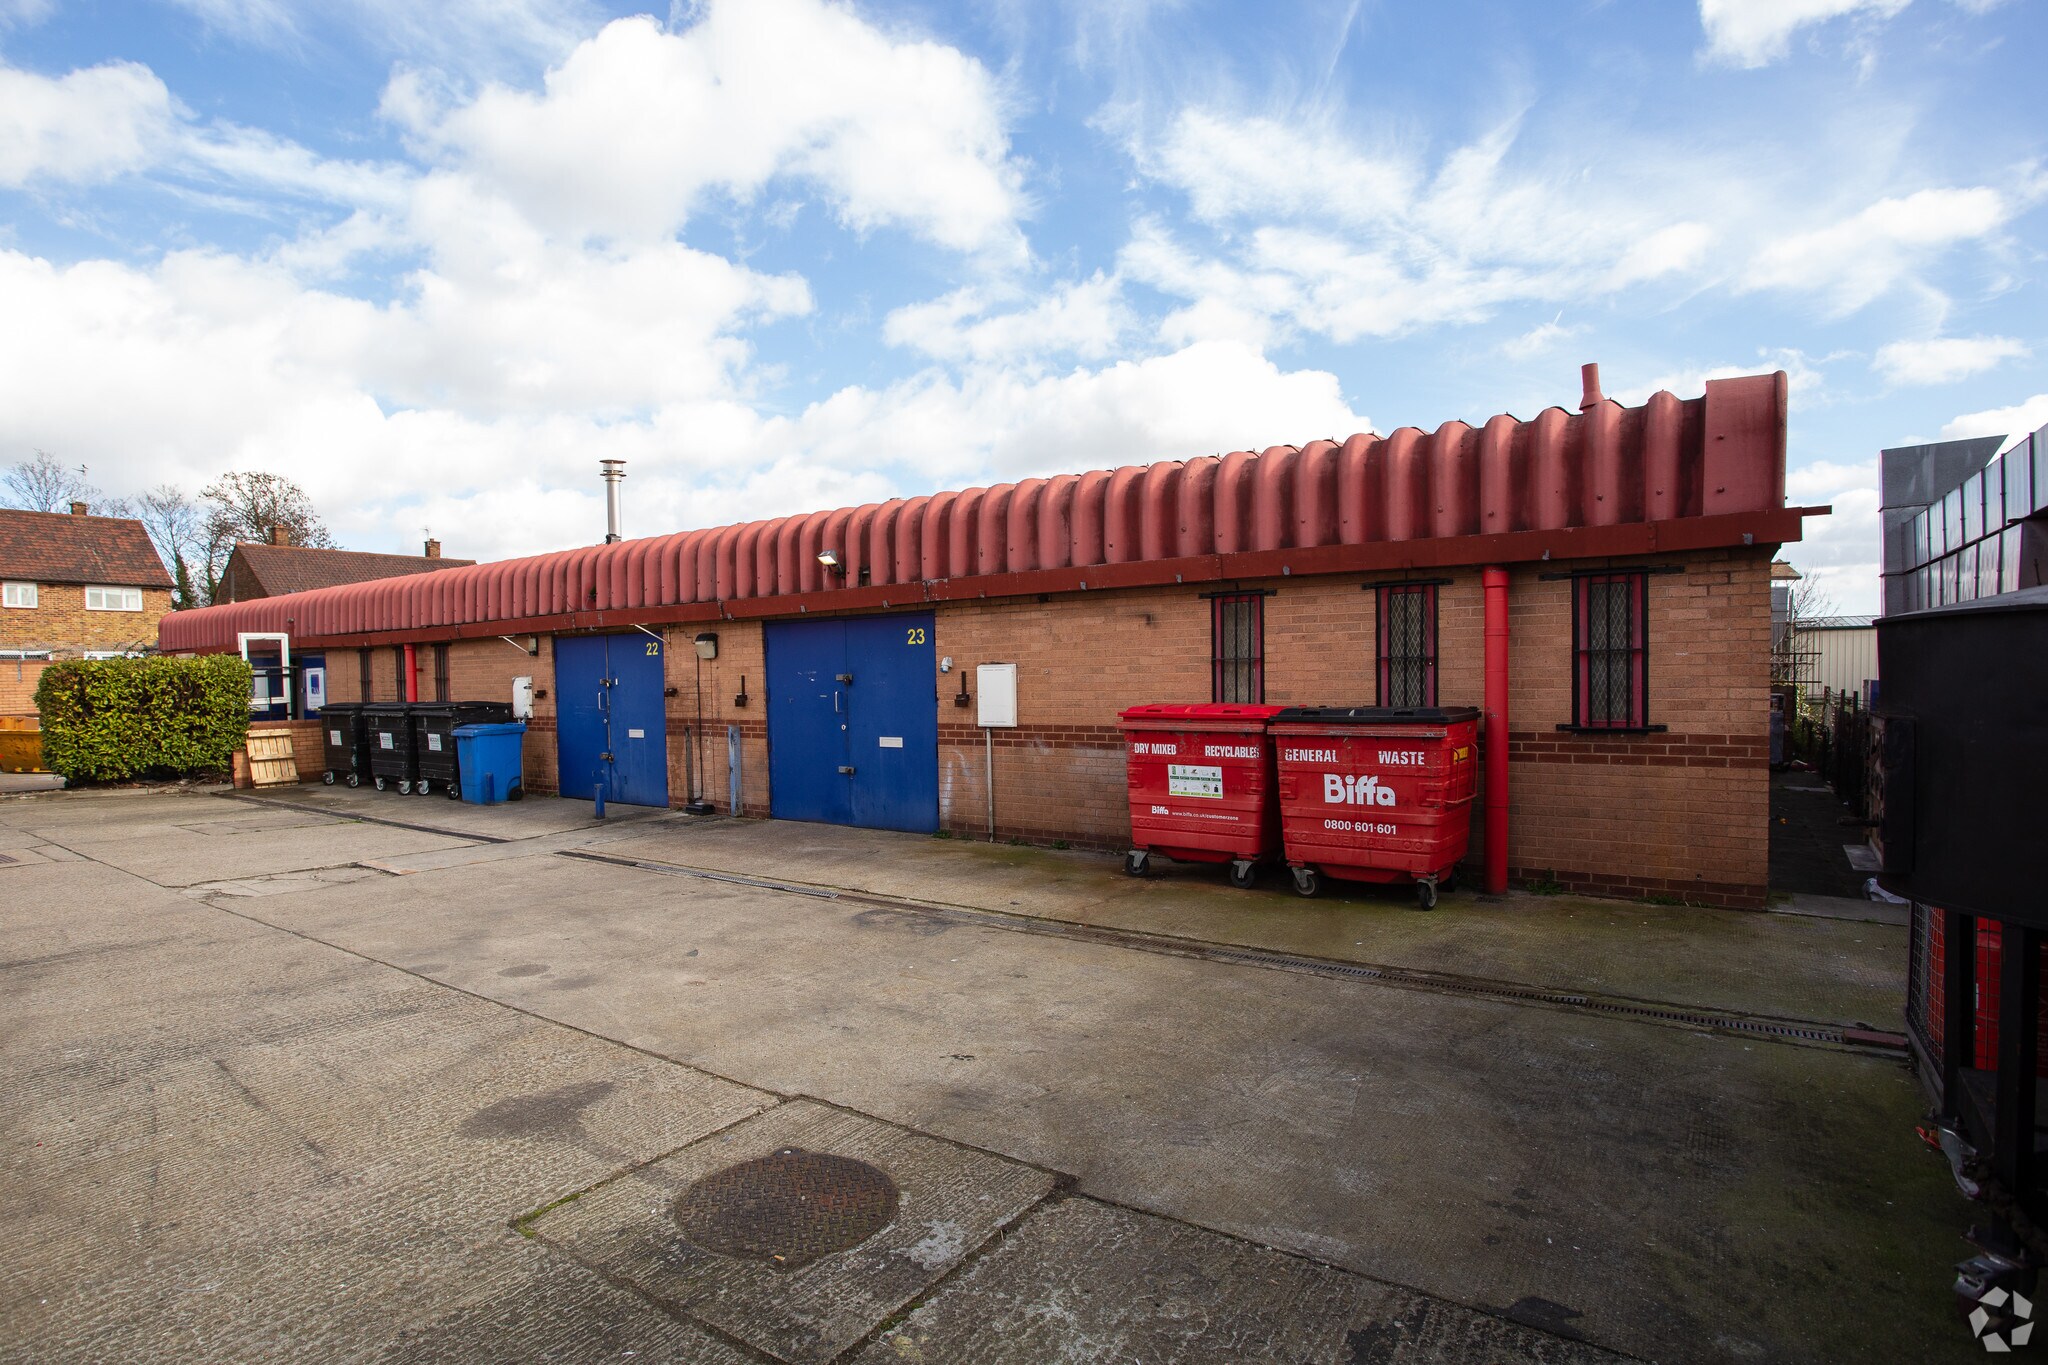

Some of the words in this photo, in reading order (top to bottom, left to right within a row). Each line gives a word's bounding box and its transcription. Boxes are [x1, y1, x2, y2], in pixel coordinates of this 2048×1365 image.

[907, 628, 925, 644] 23
[646, 642, 658, 655] 22
[1134, 743, 1149, 754] DRY
[1151, 743, 1177, 755] MIXED
[1204, 745, 1260, 758] RECYCLABLES
[1284, 748, 1339, 763] GENERAL
[1378, 750, 1425, 765] WASTE
[1323, 773, 1396, 806] Biffa
[1151, 805, 1169, 815] Biffa
[1171, 811, 1239, 820] www.biffa.co.uk/customerzone
